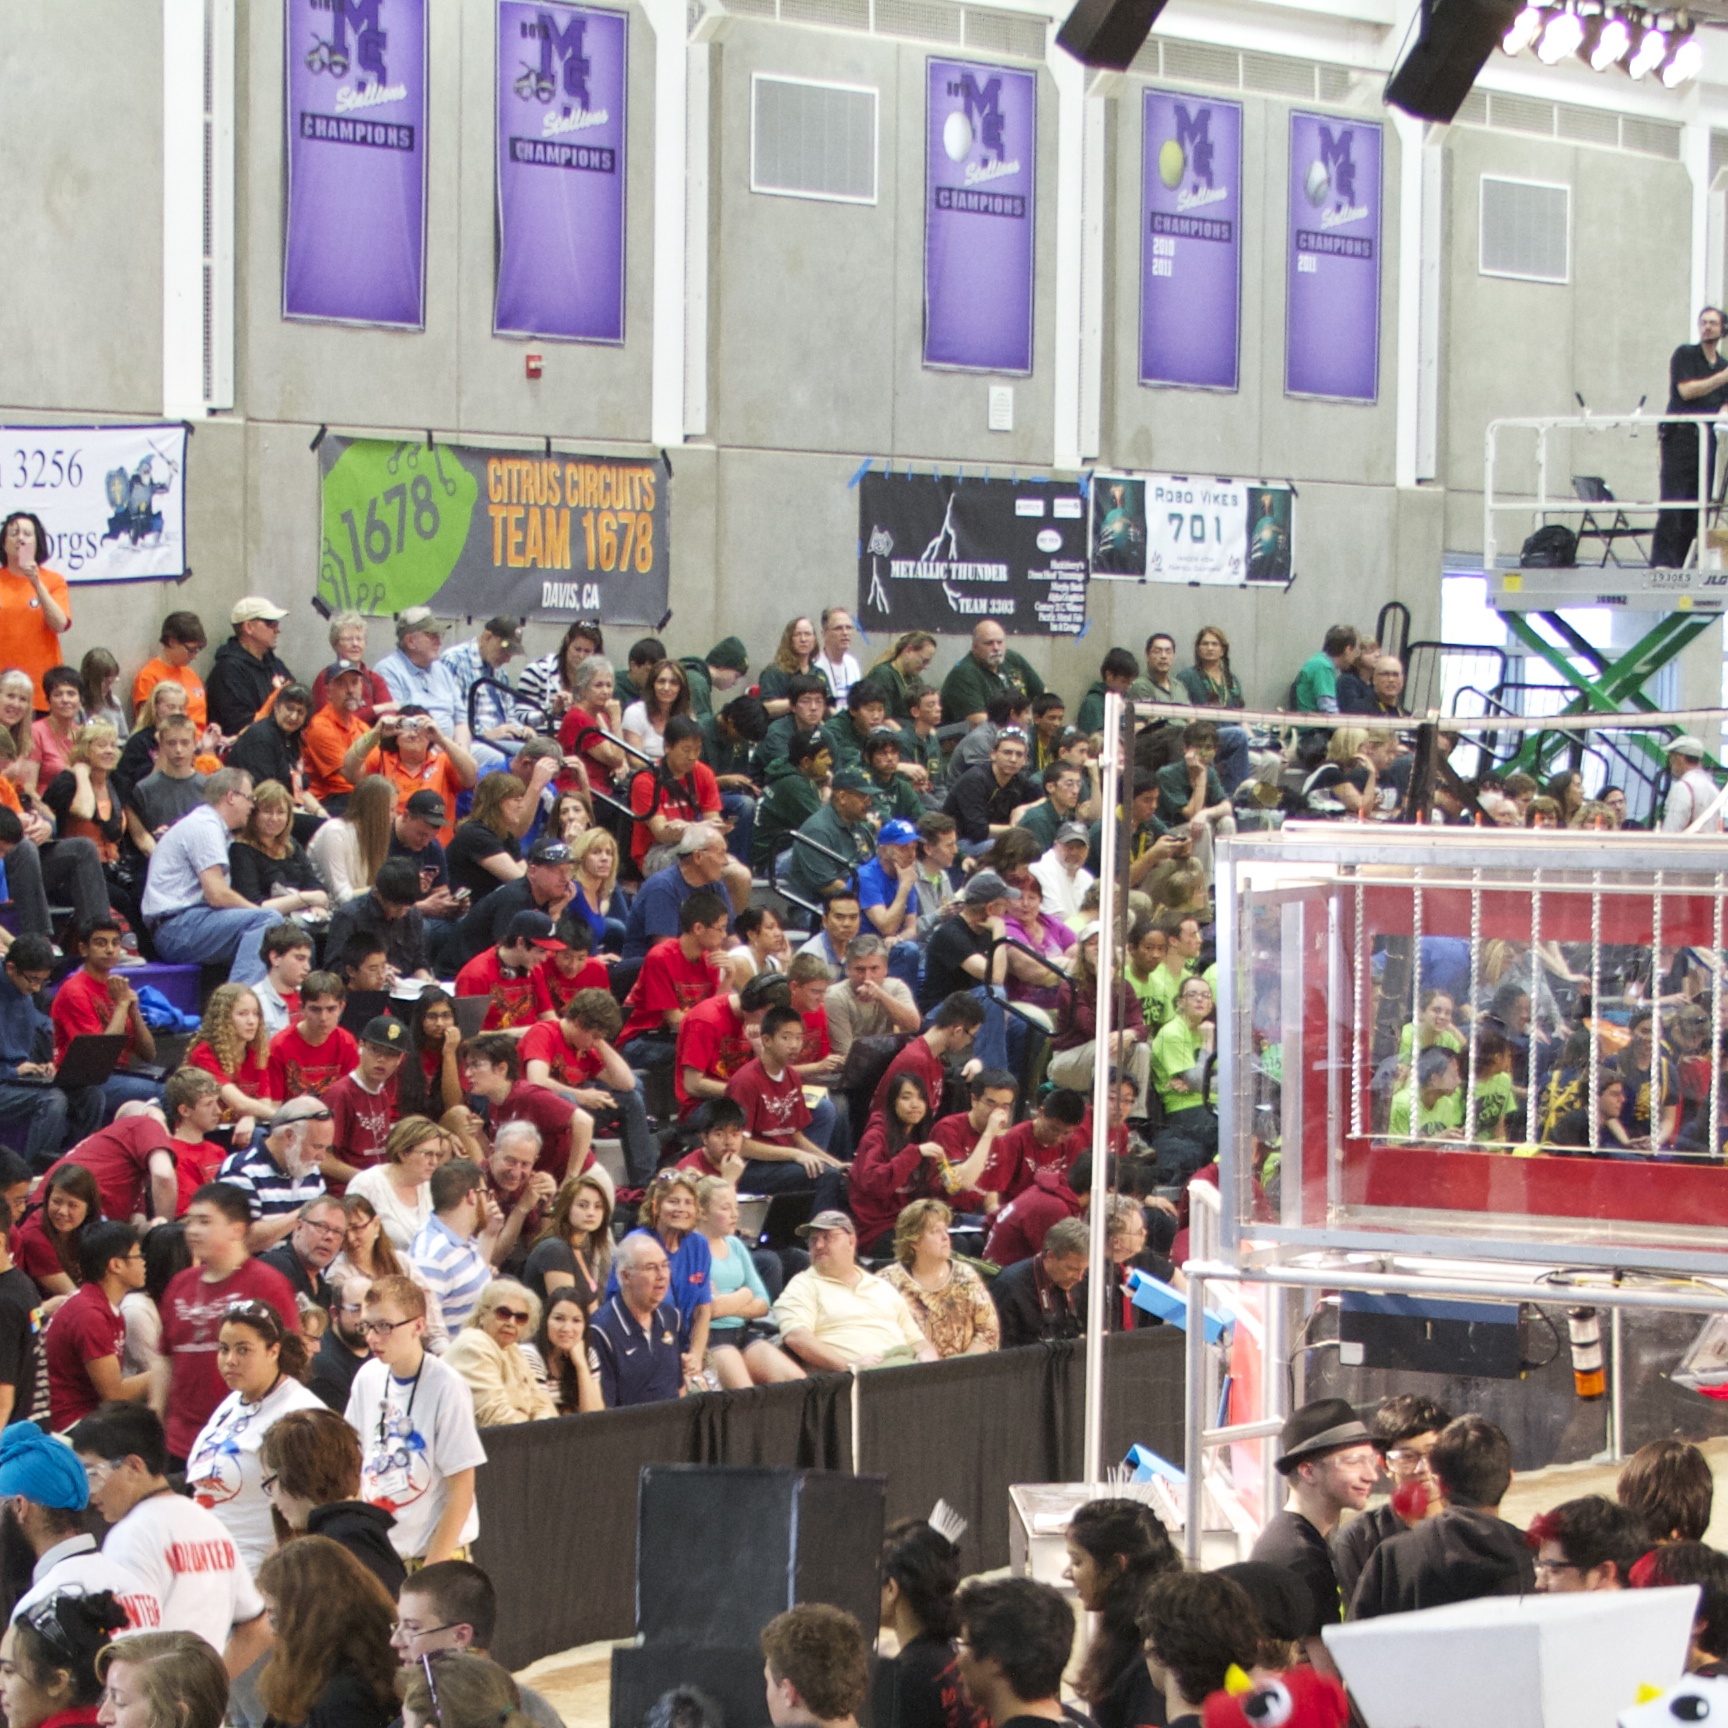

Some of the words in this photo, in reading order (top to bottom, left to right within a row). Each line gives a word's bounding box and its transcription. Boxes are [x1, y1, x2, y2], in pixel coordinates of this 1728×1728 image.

[302, 114, 412, 149] CHAMPIONS
[514, 140, 613, 170] CHAMPIONS
[938, 188, 1025, 217] CHAMPIONS
[1153, 214, 1231, 242] CHAMPIONS
[1152, 236, 1175, 258] 2010
[1298, 231, 1371, 258] CHAMPIONS
[1152, 258, 1173, 277] 2011
[1297, 253, 1318, 274] 2011
[13, 448, 84, 490] 3256
[487, 457, 561, 507] CITRUS
[564, 462, 657, 512] CIRCUITS
[340, 474, 441, 574] 1678
[488, 503, 572, 570] TEAM
[582, 509, 654, 574] 1678
[1167, 512, 1222, 545] 701
[890, 559, 948, 579] METALLIC
[949, 561, 1009, 583] THUNDER
[1703, 574, 1728, 587] JLG
[541, 581, 580, 611] DAVIS,
[582, 583, 600, 610] CA
[957, 598, 987, 614] TEAM
